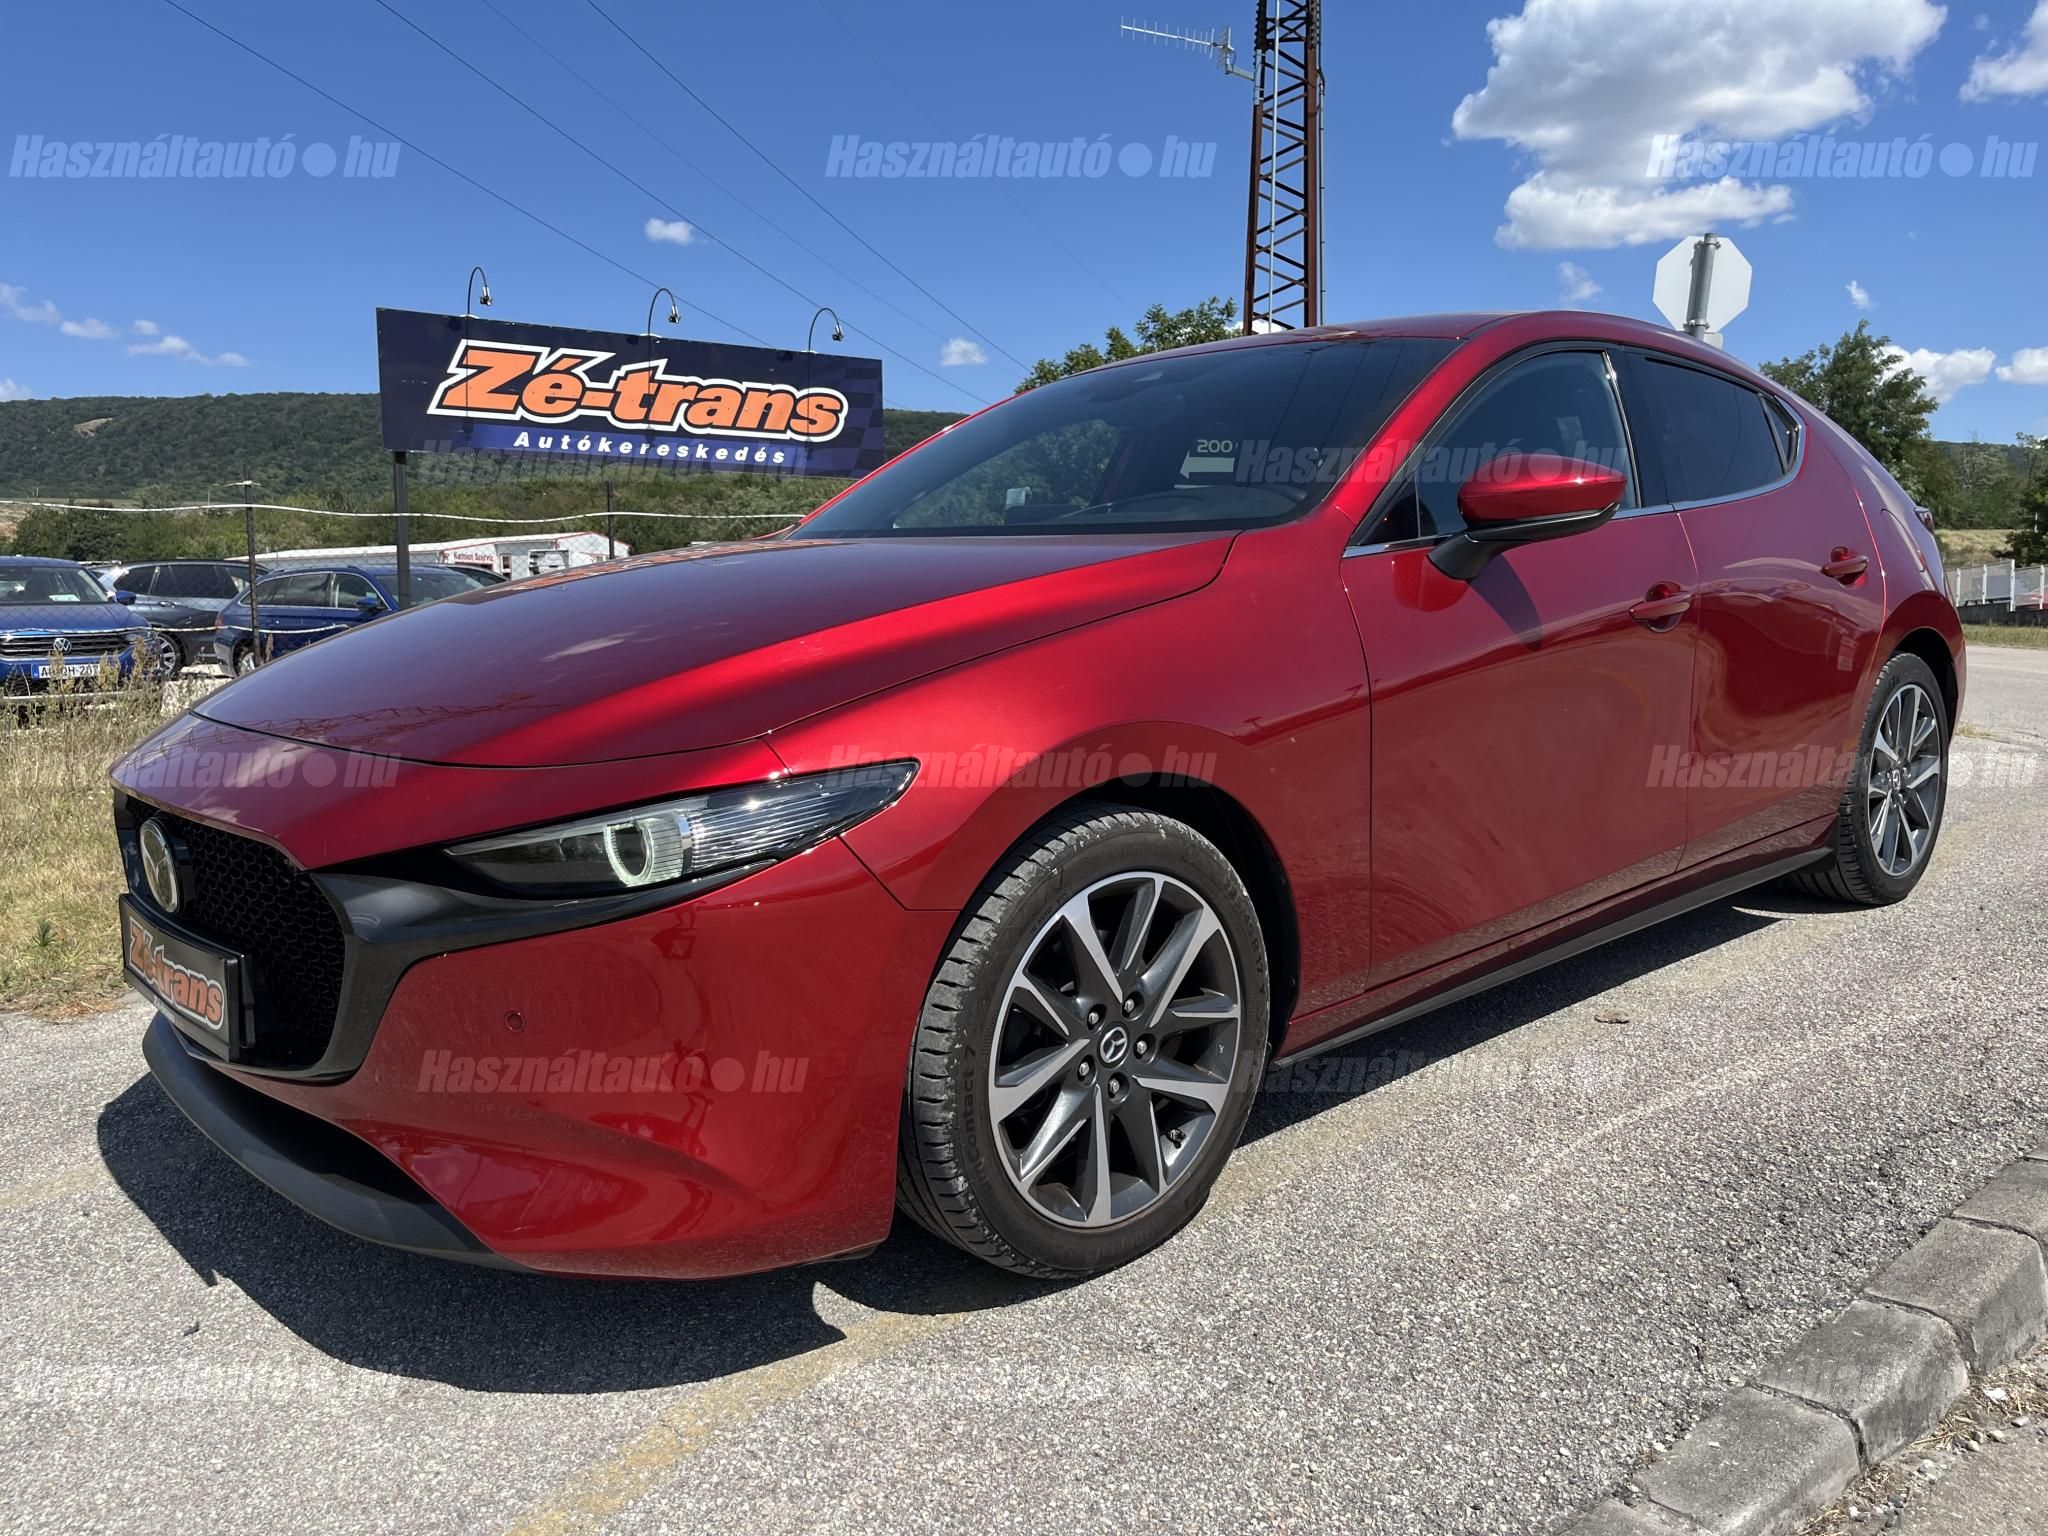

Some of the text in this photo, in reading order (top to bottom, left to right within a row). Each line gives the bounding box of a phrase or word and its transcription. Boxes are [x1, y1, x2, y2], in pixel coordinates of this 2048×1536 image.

[433, 344, 845, 440] Zé-trans
[514, 431, 786, 464] Autókereskedés
[1196, 439, 1233, 453] 200
